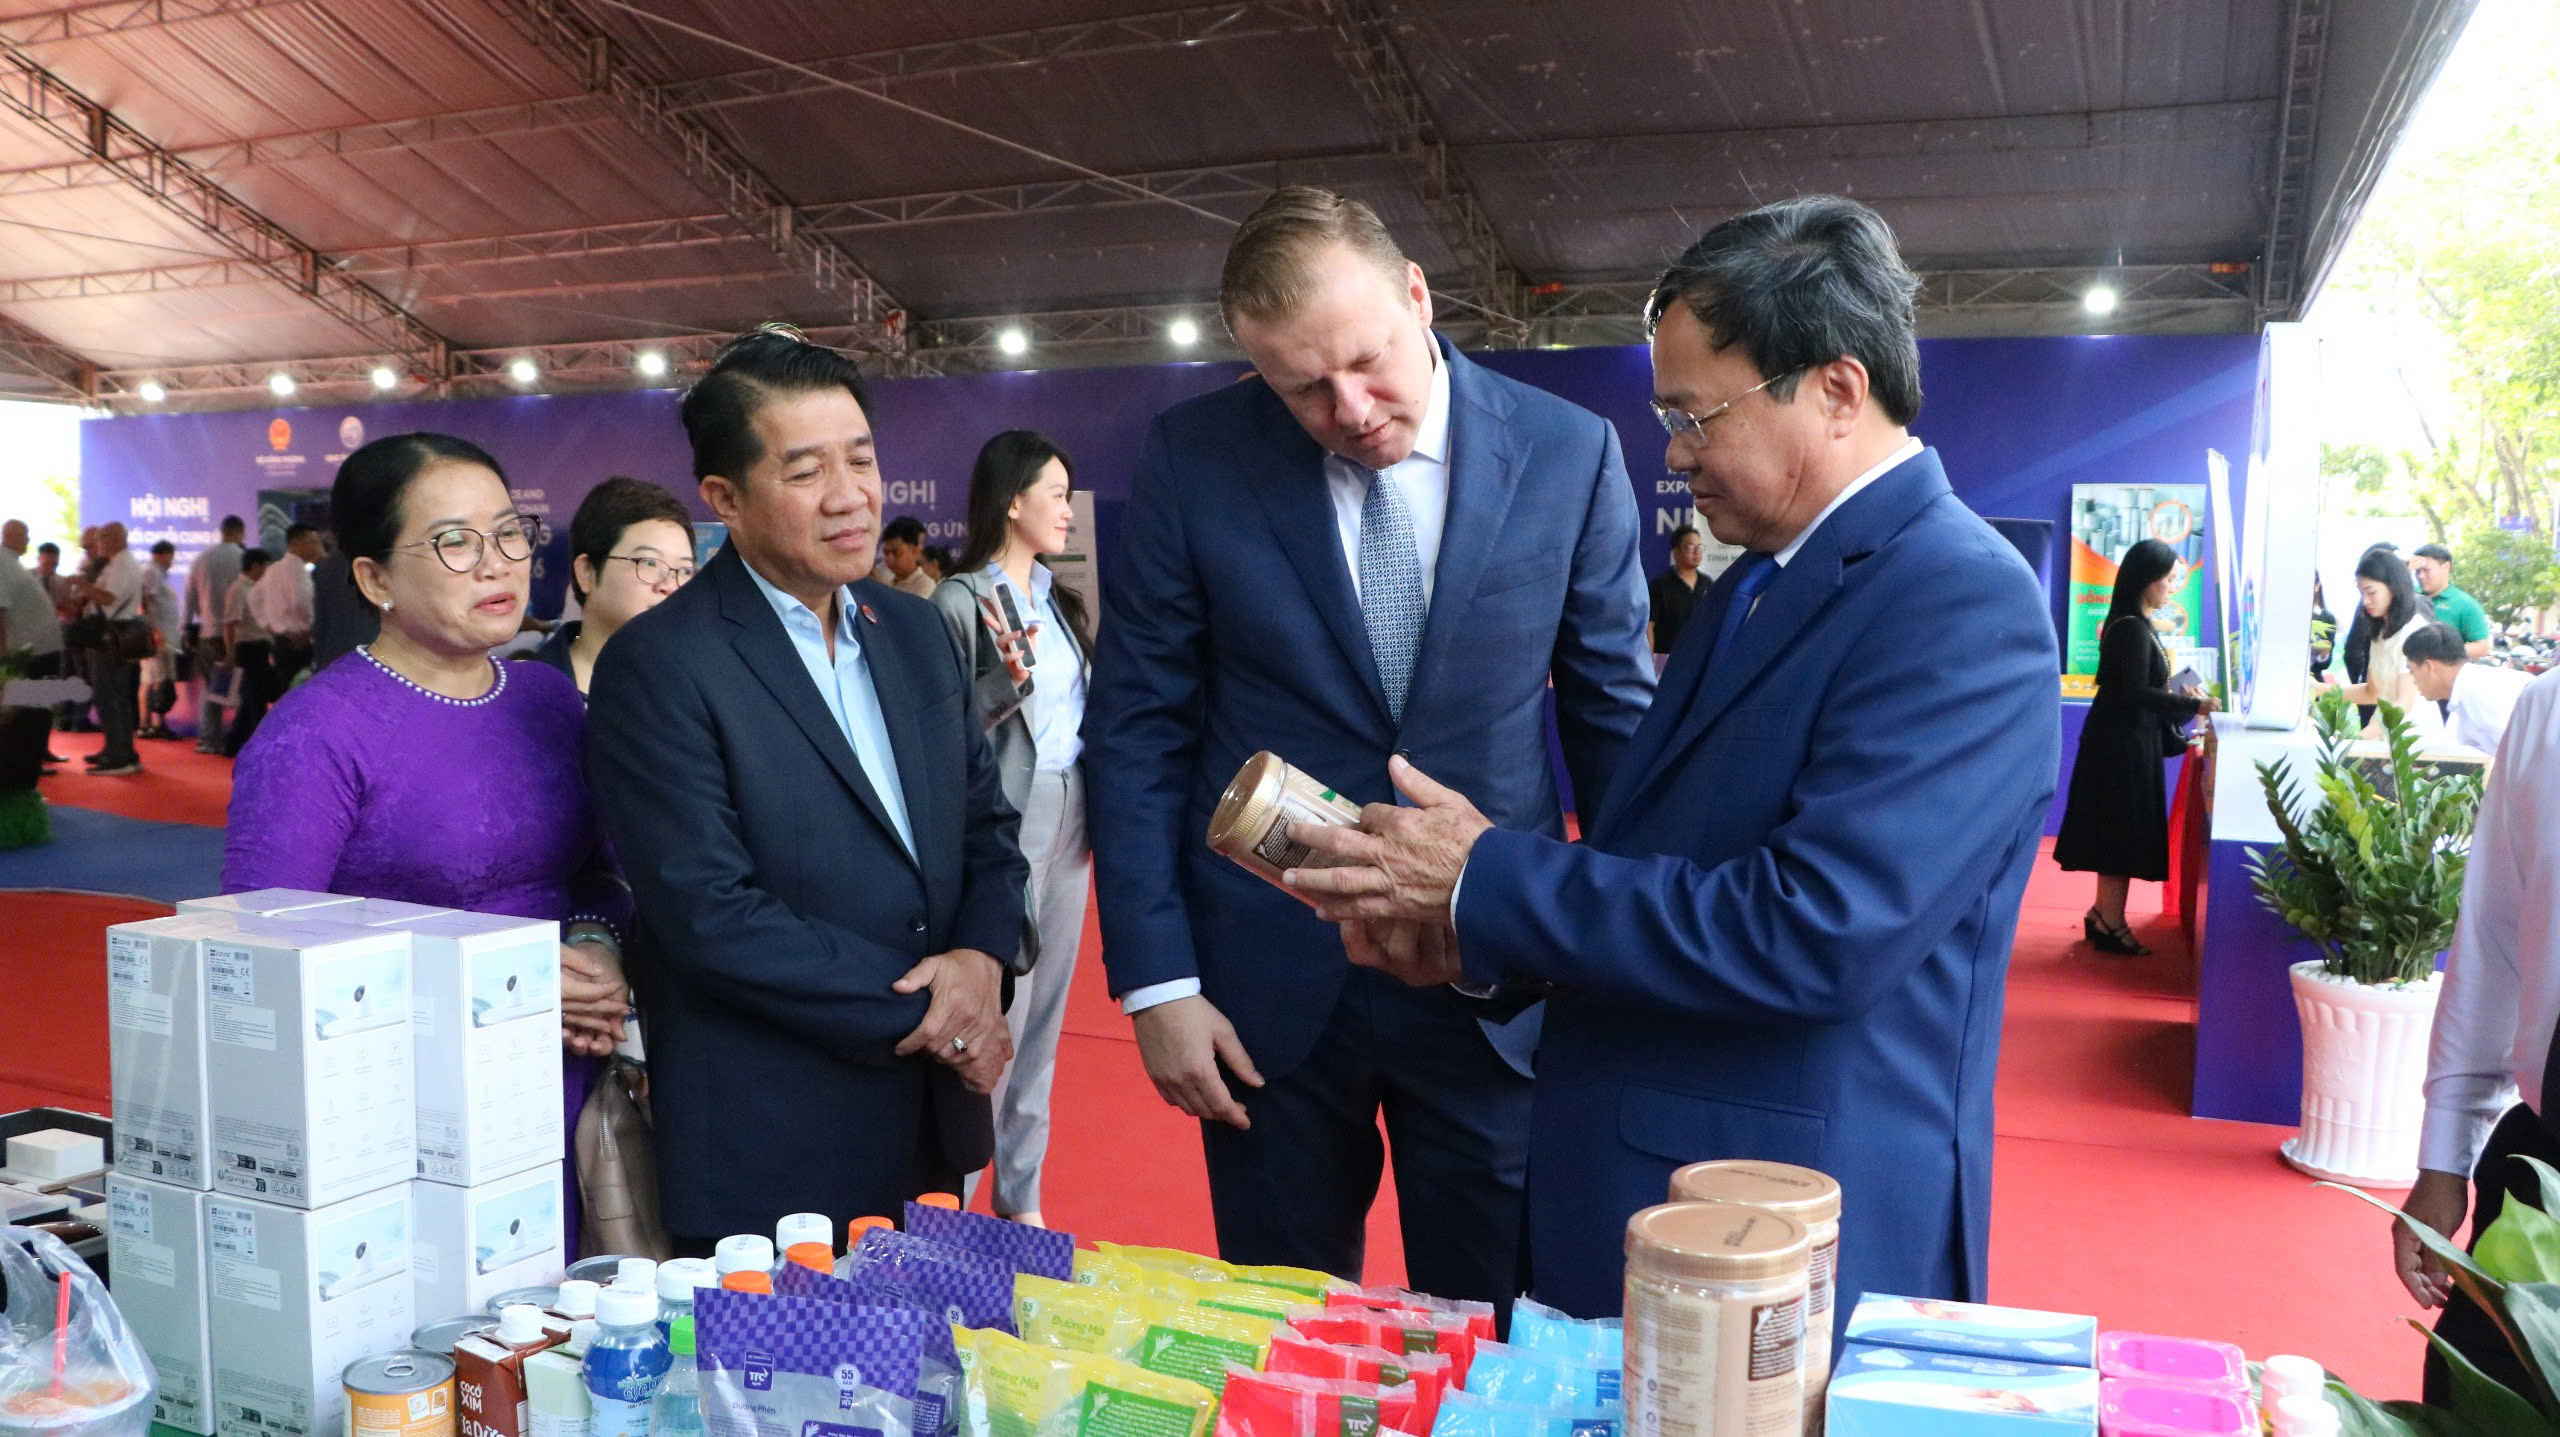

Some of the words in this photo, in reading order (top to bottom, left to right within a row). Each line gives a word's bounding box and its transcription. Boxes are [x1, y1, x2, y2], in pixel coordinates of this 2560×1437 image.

[881, 479, 936, 511] GHỊ
[164, 497, 209, 523] NGHỊ
[1079, 1273, 1092, 1284] 55
[1023, 1301, 1033, 1312] 55
[951, 1310, 960, 1321] 55
[841, 1369, 854, 1379] 55
[460, 1391, 483, 1414] XIM
